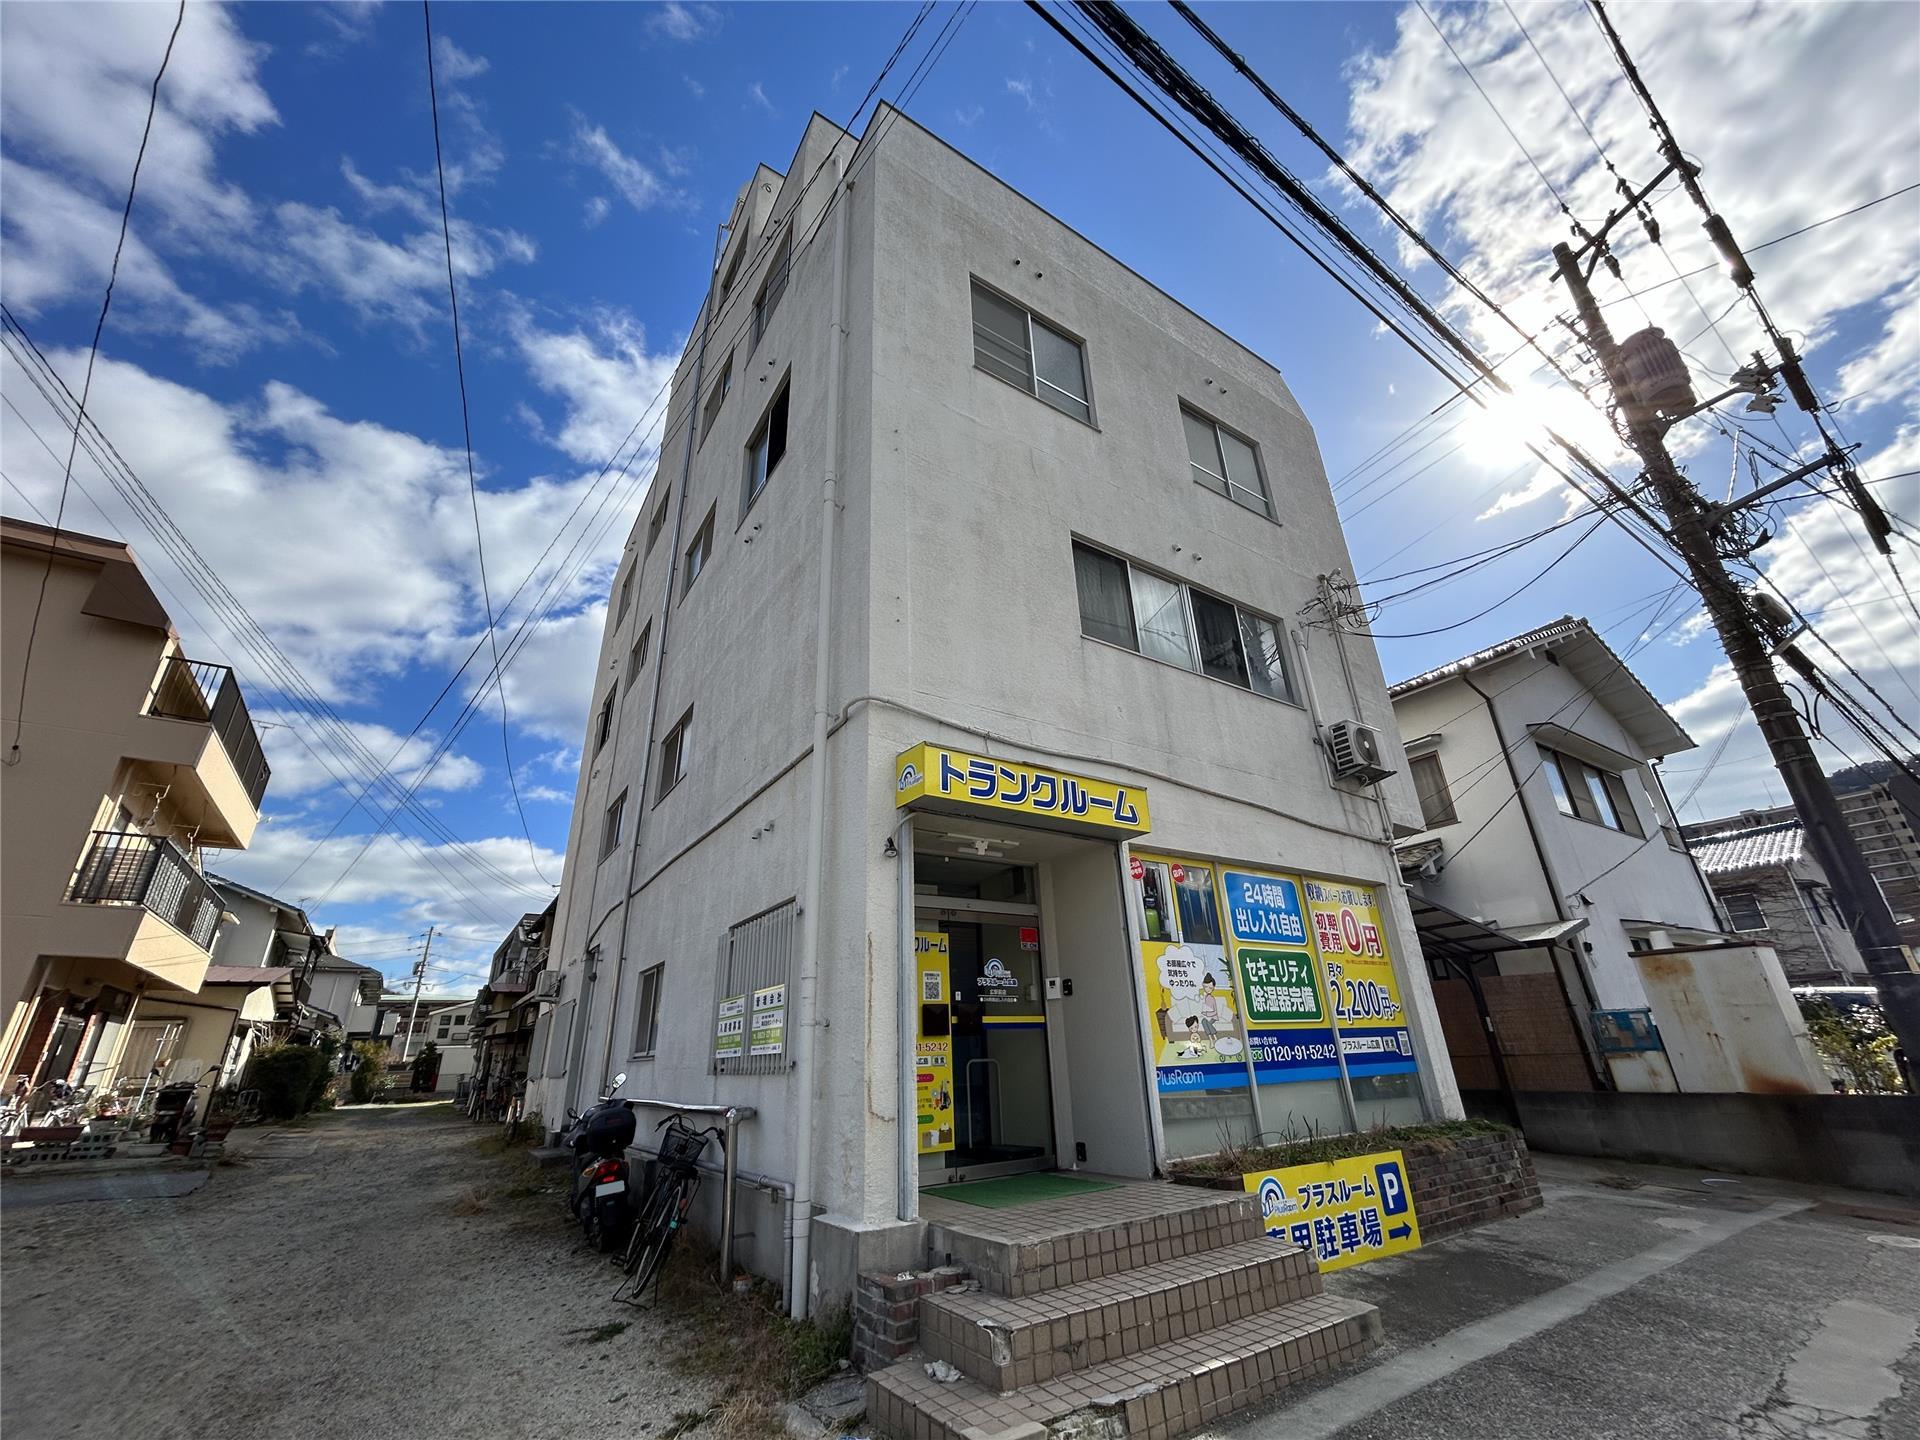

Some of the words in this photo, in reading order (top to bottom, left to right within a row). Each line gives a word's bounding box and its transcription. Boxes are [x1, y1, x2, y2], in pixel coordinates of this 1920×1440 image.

[940, 753, 1138, 823] トランクルーム
[1243, 882, 1286, 909] 24時間
[1236, 907, 1302, 937] 出し入れ自由
[1167, 959, 1196, 969] お部屋広々で
[1168, 969, 1189, 979] 気持ちも
[1246, 957, 1308, 984] セキュリティ
[1327, 962, 1343, 977] 月々
[1250, 986, 1317, 1012] 除湿器完備
[1156, 1069, 1205, 1086] PlusRoom
[1298, 1176, 1376, 1210] プラスルーム
[1382, 1172, 1398, 1209] P
